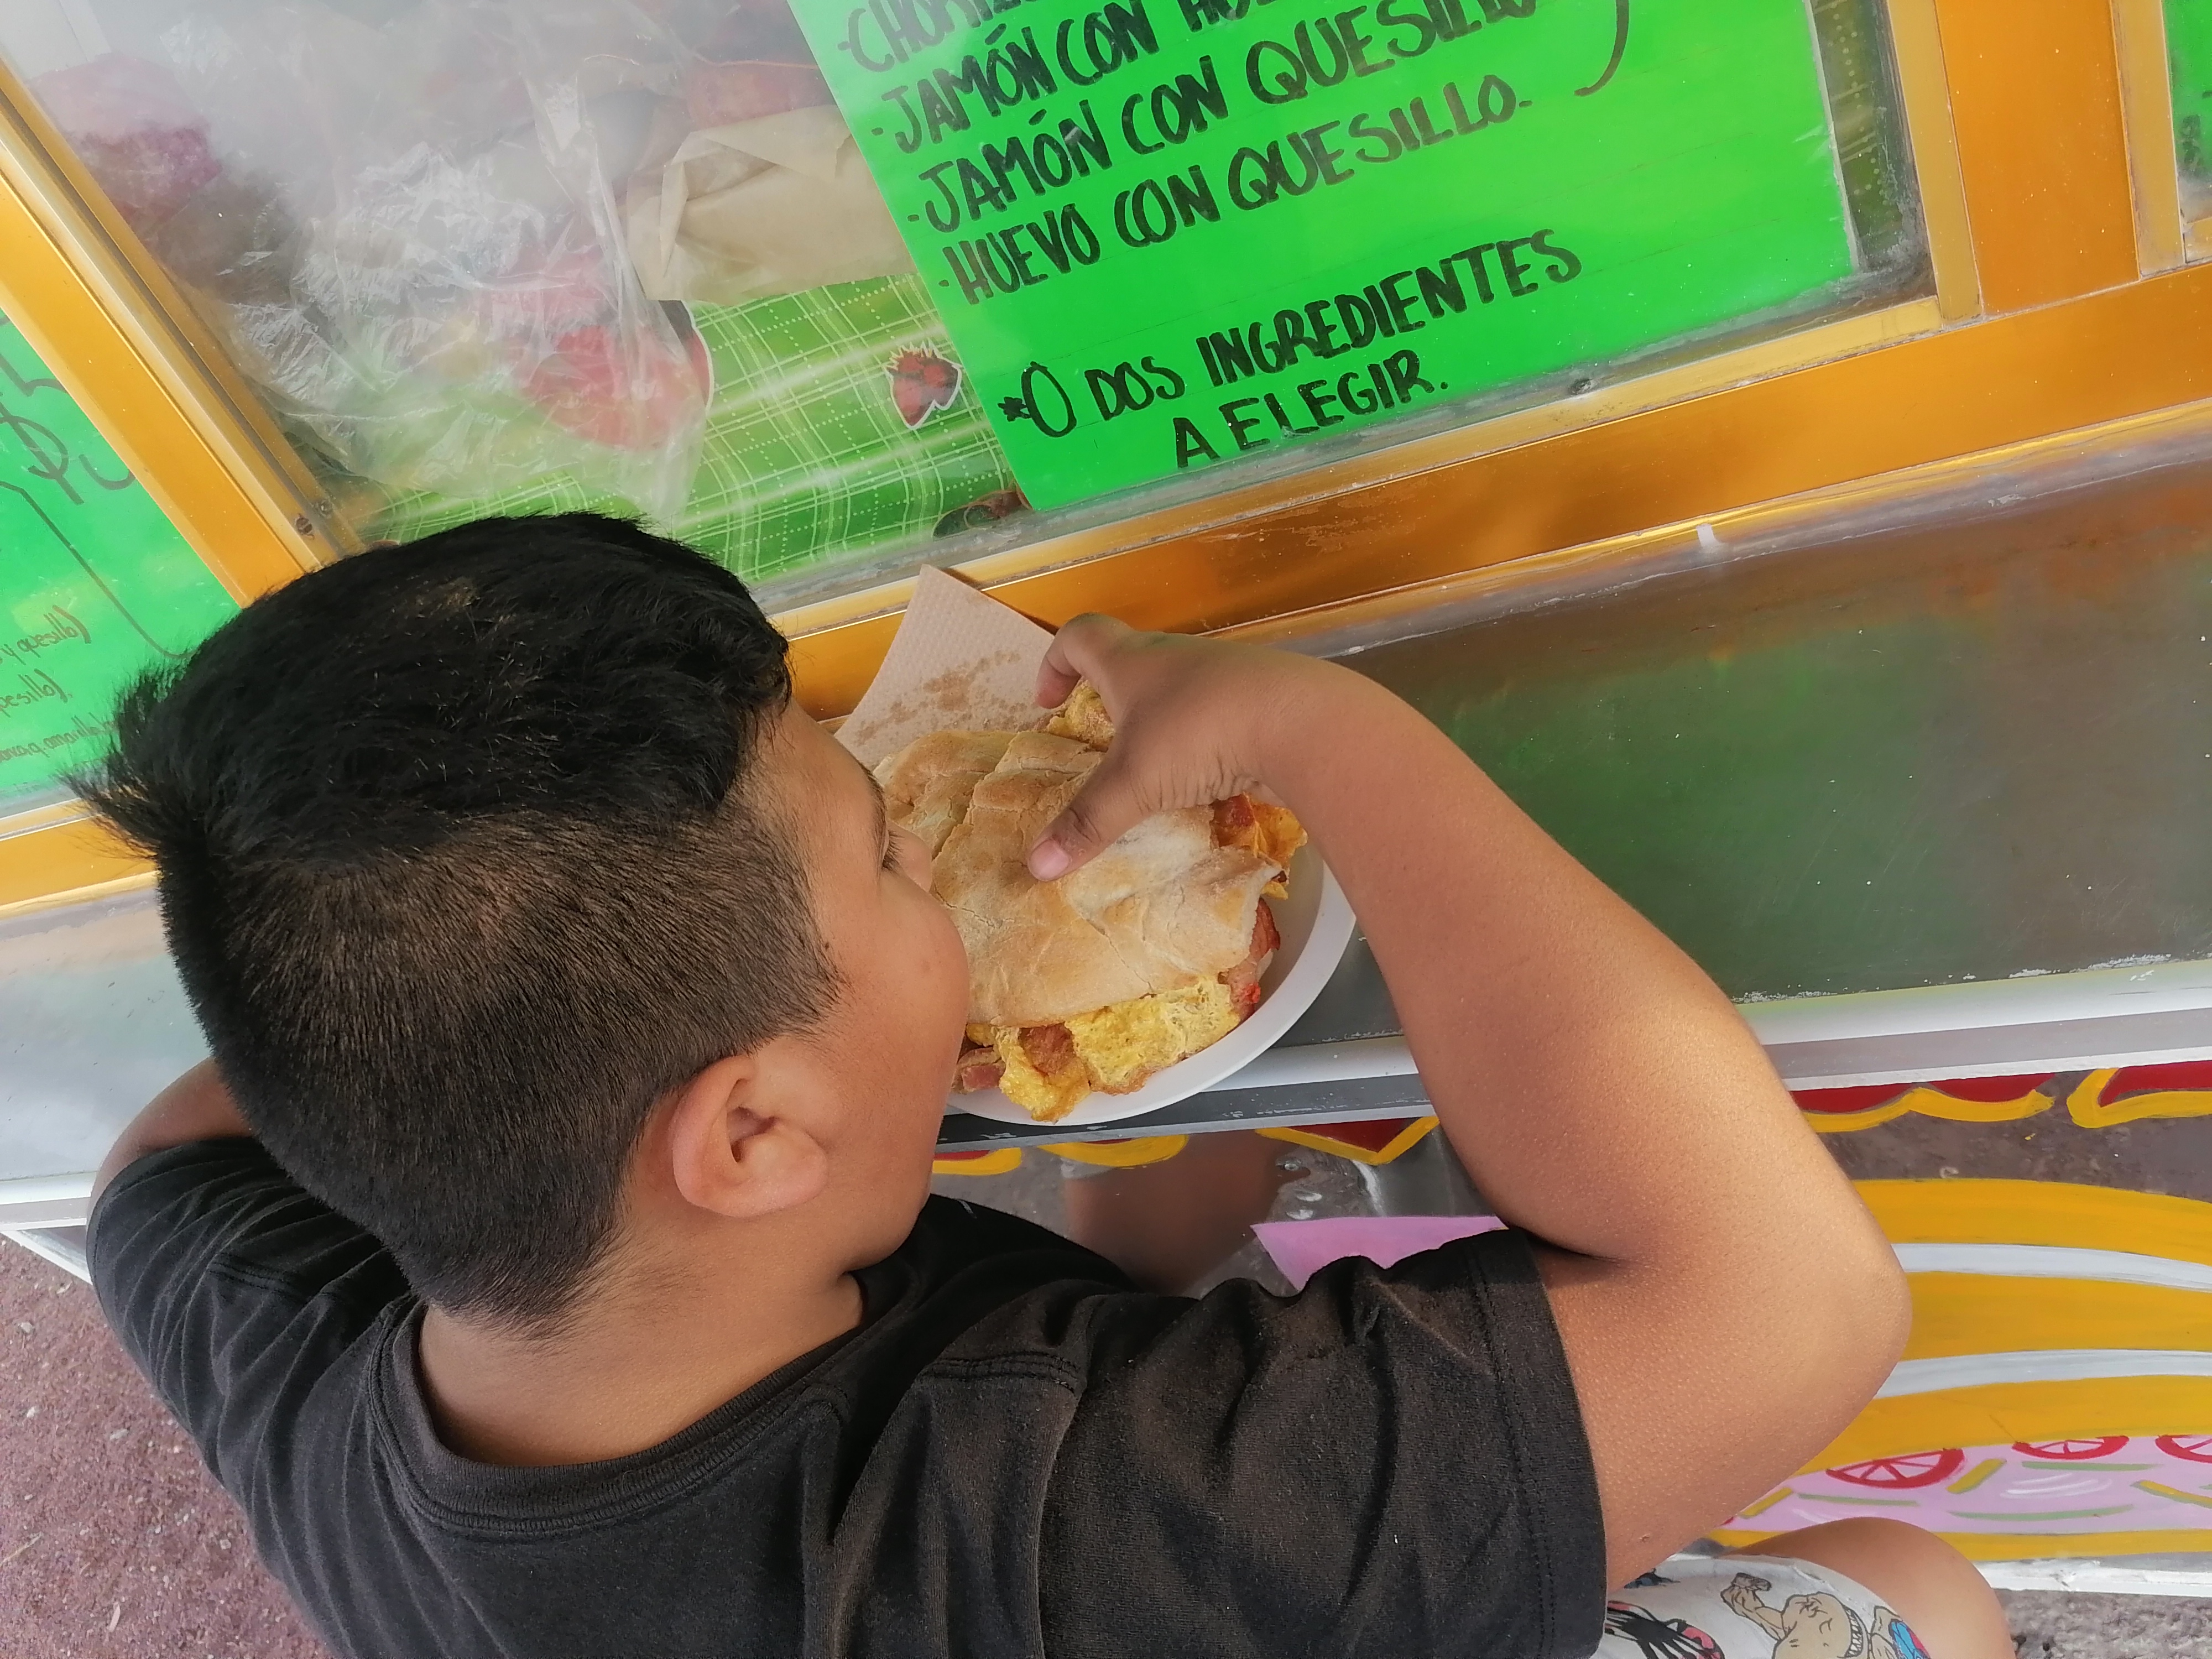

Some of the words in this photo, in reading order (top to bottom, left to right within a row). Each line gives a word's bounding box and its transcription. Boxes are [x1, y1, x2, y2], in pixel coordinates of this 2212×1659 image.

[1056, 0, 1160, 86] CON
[1121, 55, 1228, 155] CON
[1114, 164, 1221, 247] CON
[1084, 356, 1185, 421] DOS
[1195, 228, 1583, 388] INGREDIENTES
[1172, 416, 1220, 468] A
